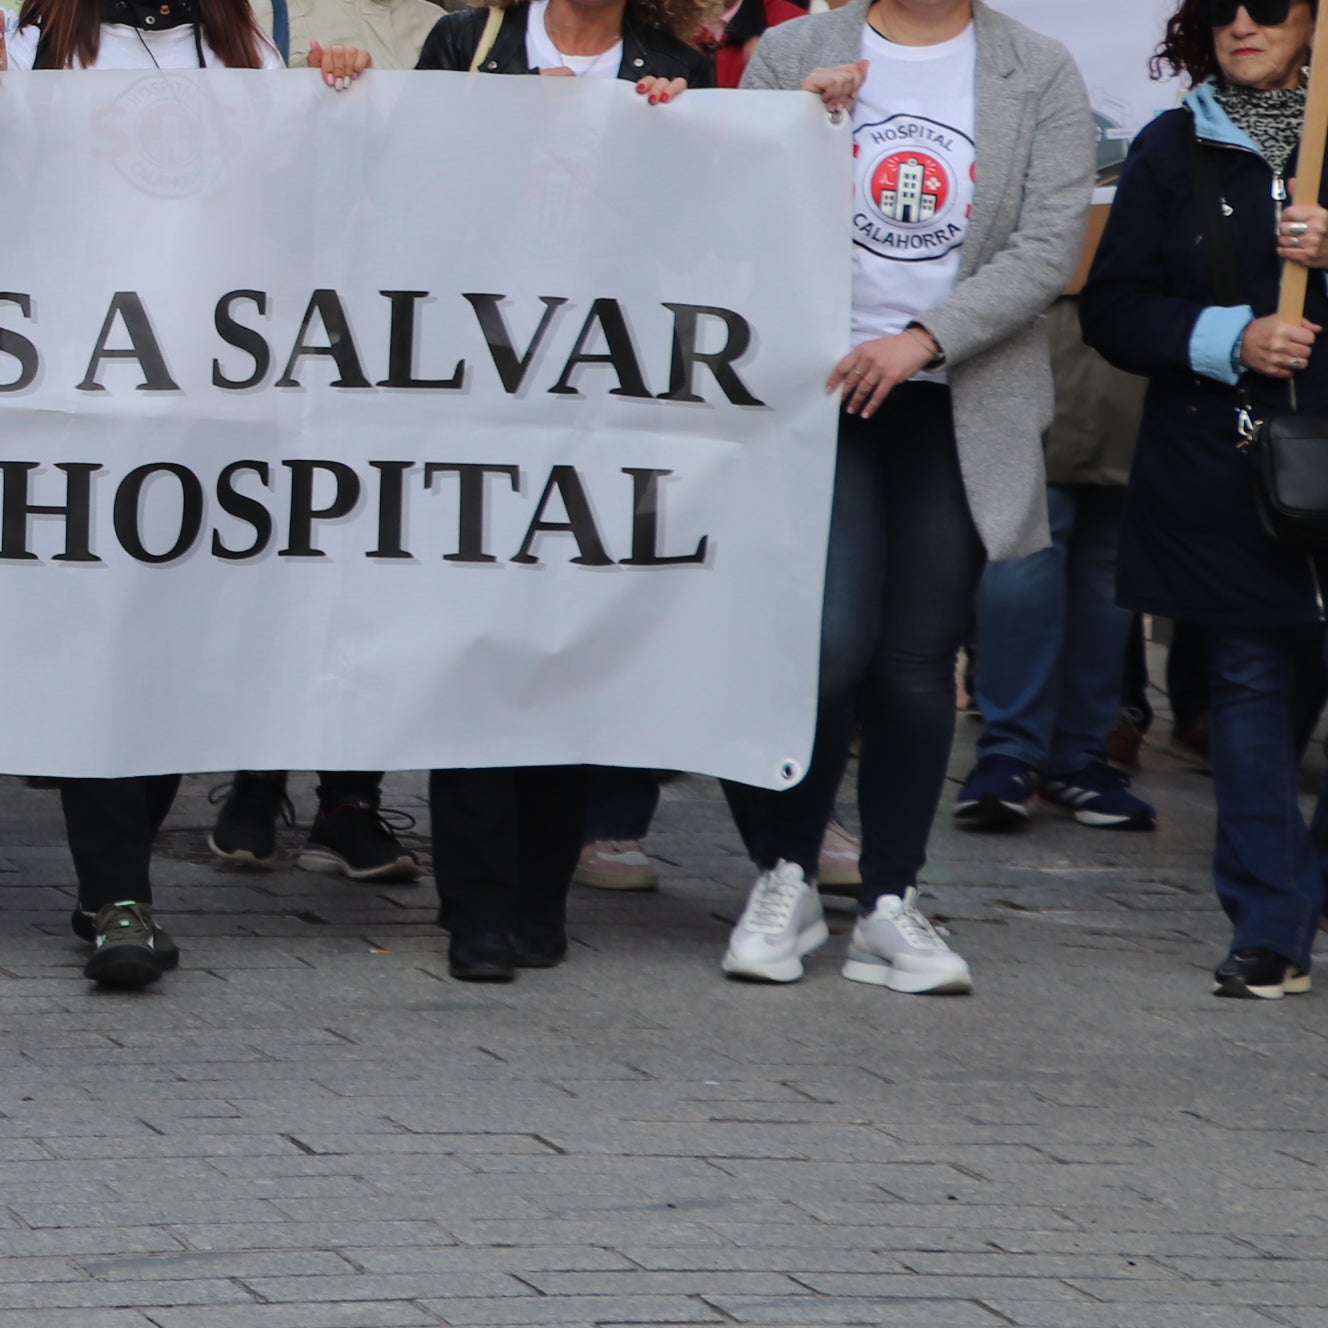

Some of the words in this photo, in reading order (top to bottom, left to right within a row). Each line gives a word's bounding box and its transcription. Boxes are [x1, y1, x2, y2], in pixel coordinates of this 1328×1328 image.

[871, 124, 955, 152] HOSPITAL
[853, 213, 962, 249] CALAHORRA
[75, 290, 182, 392] A
[211, 288, 767, 407] SALVAR
